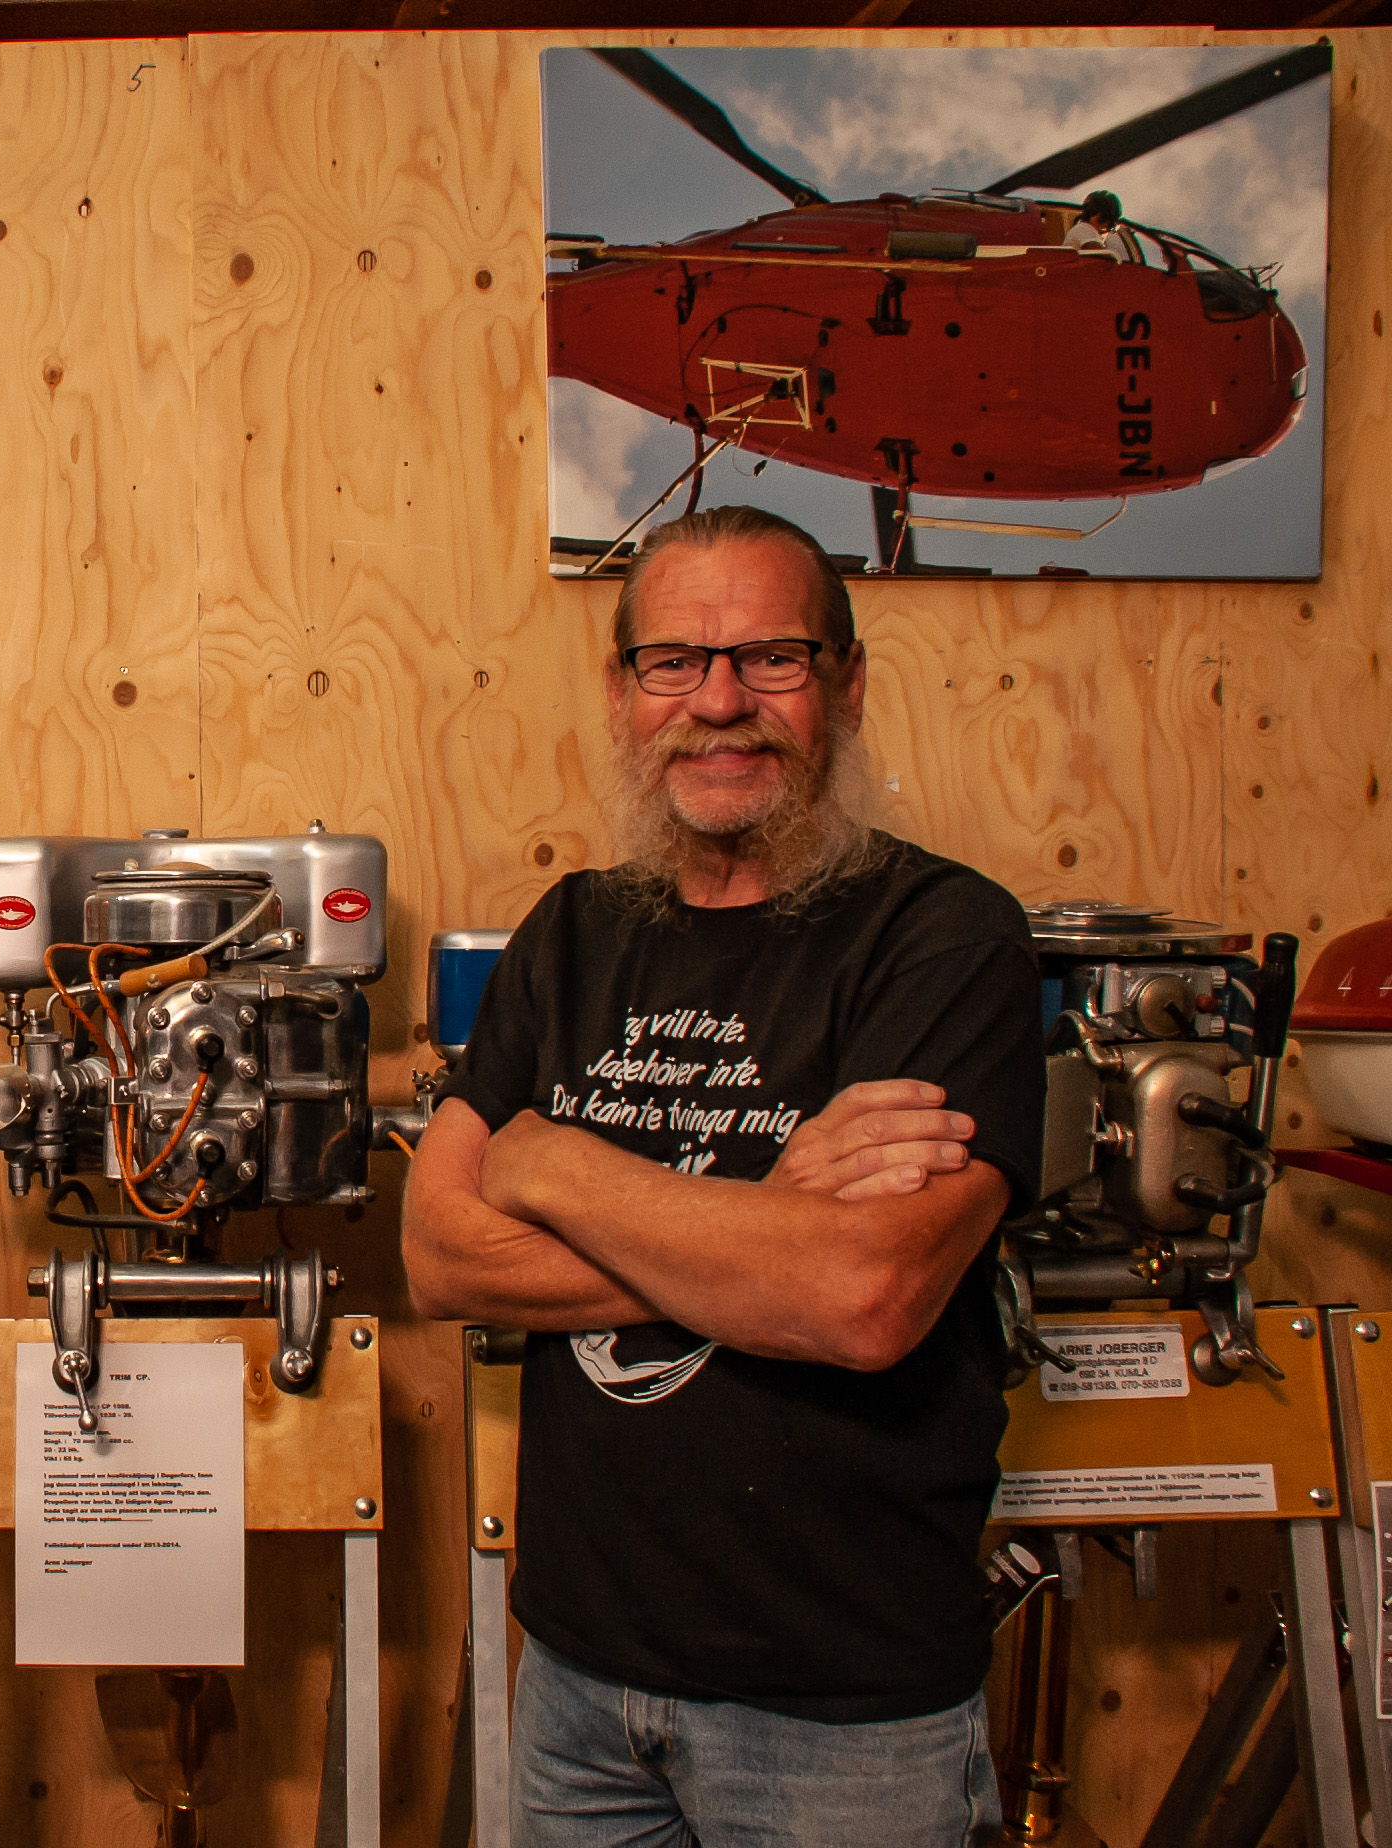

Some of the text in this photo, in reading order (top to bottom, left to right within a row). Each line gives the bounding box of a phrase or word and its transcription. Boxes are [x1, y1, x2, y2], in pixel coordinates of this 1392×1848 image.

[127, 64, 156, 92] 5
[1115, 312, 1153, 477] SE-JBN
[650, 1008, 697, 1039] vill
[691, 1009, 746, 1043] inte.
[705, 1056, 762, 1088] inte.
[668, 1098, 737, 1144] tvinga
[738, 1102, 803, 1144] mig
[1058, 1342, 1166, 1355] ARNE JOBERGER
